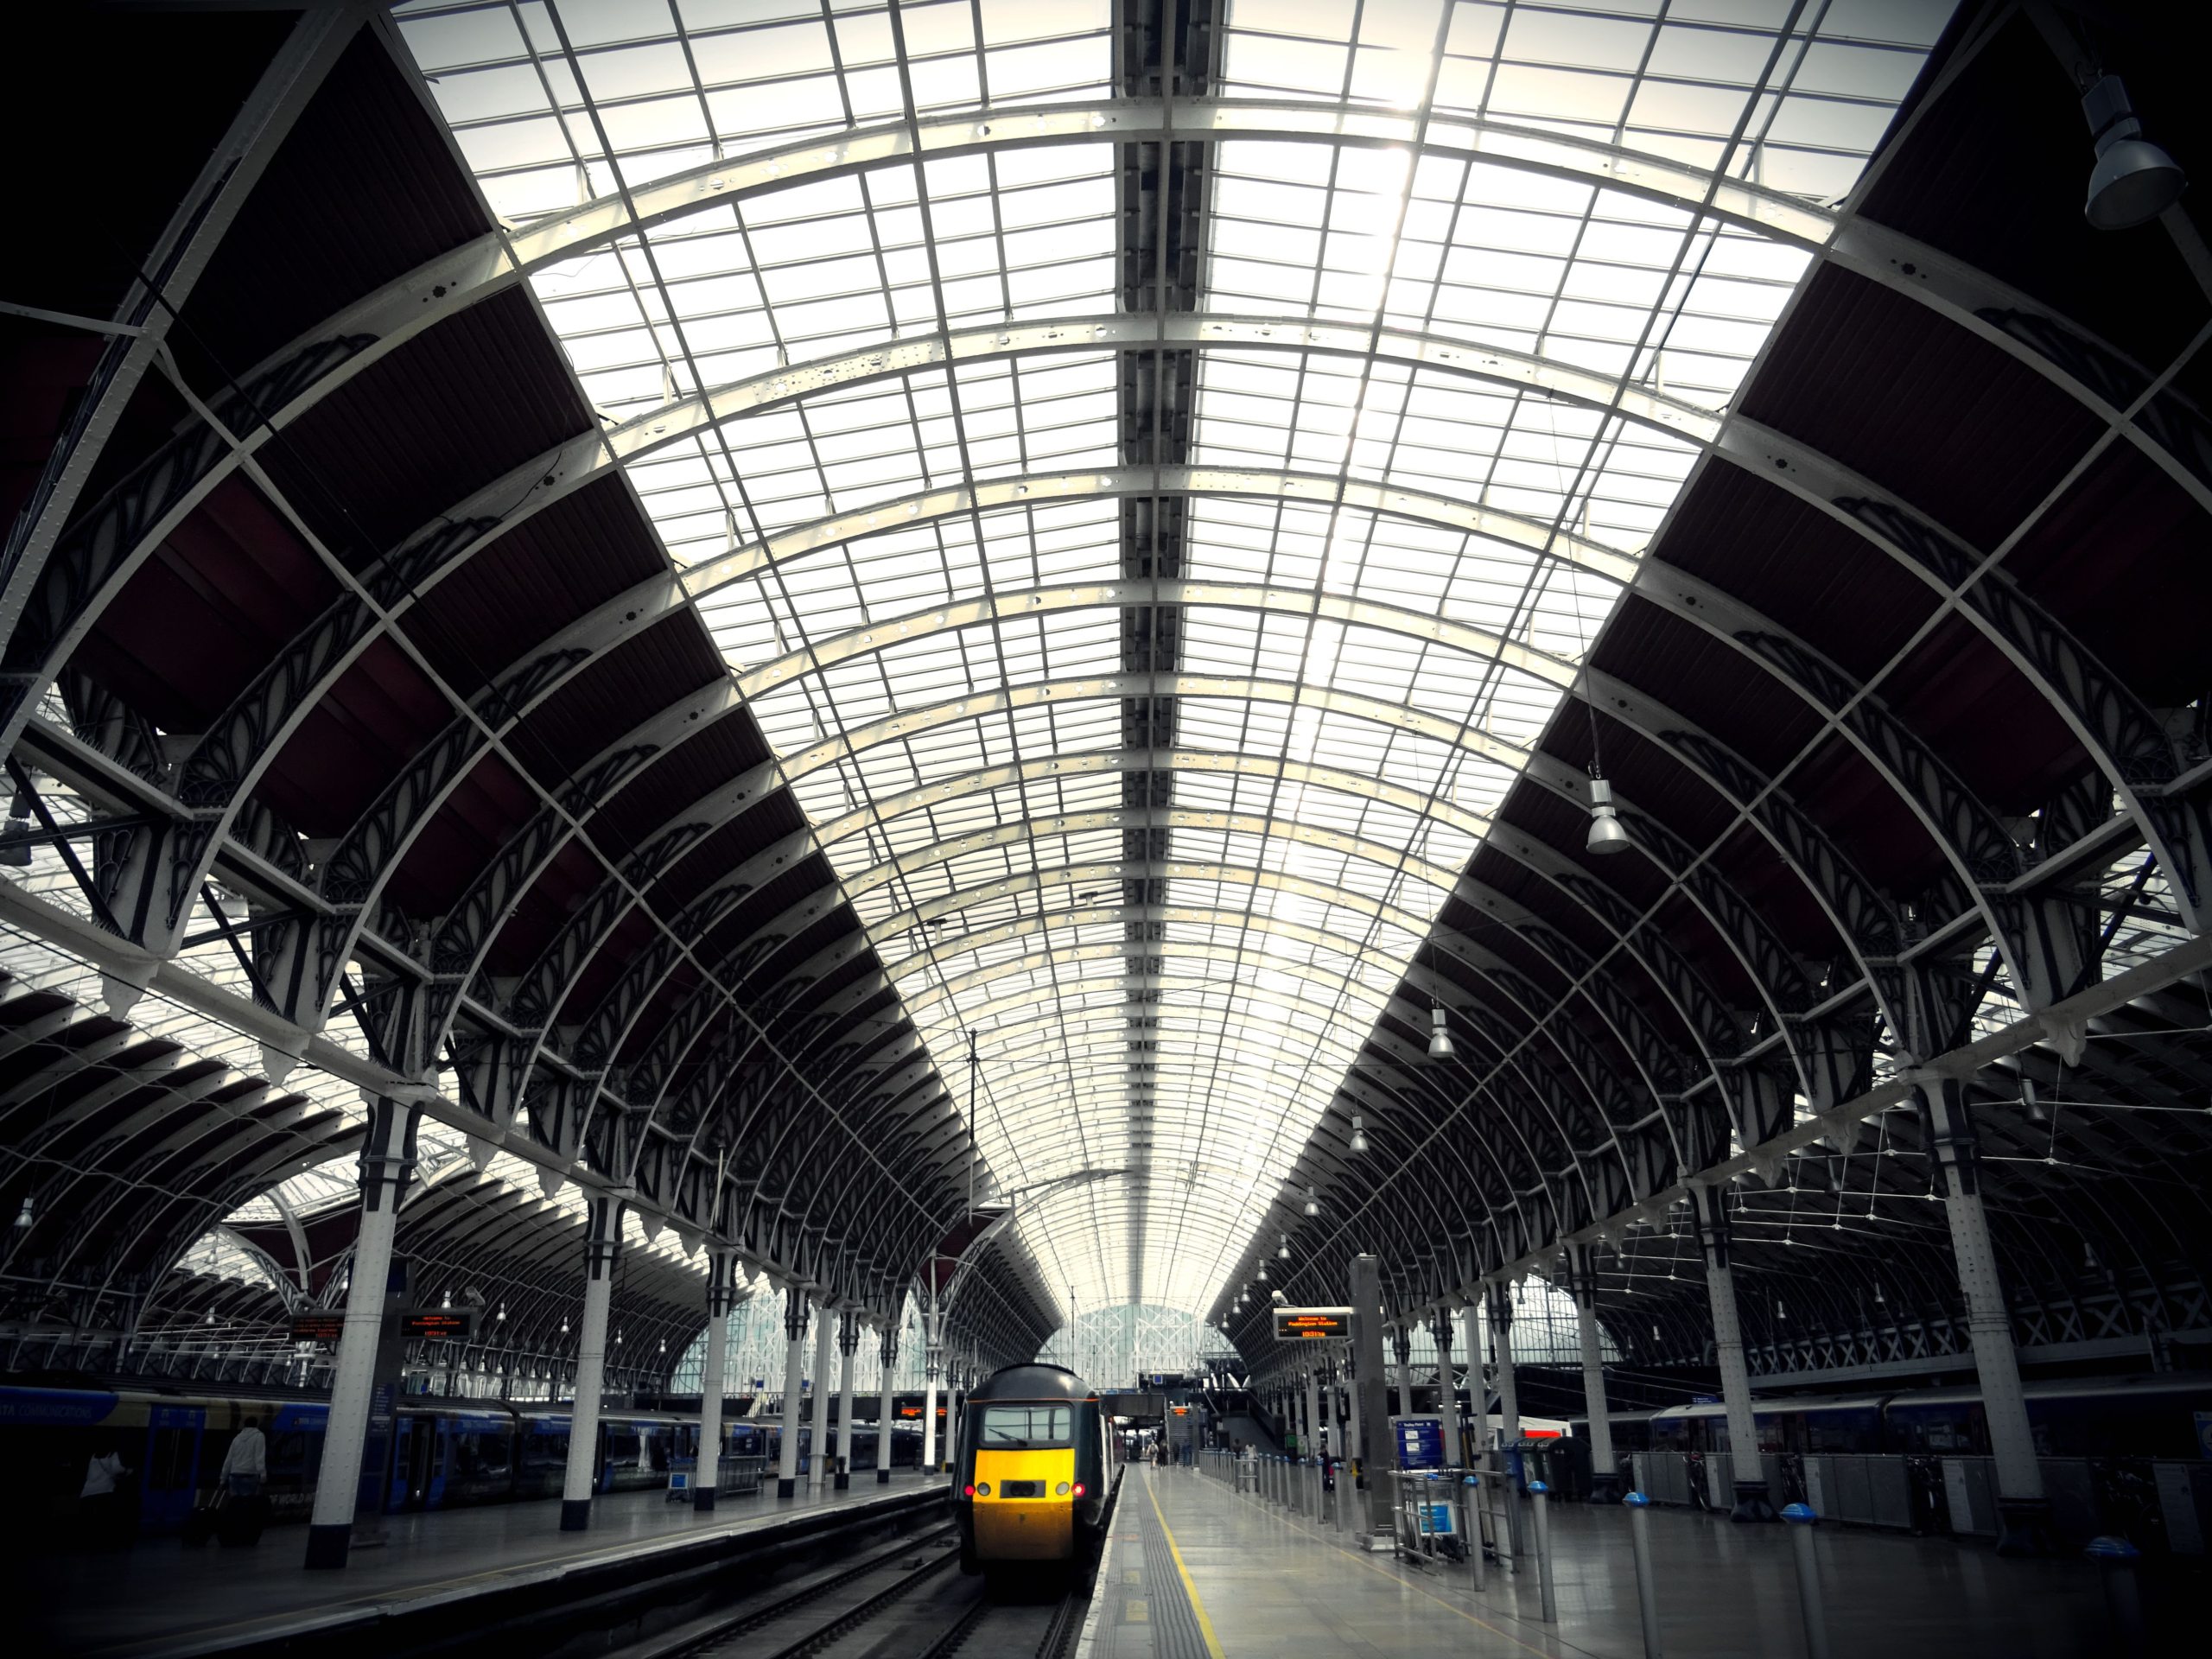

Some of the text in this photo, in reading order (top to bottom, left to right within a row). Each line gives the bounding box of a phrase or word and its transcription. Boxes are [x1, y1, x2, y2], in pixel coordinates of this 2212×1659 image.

[0, 1404, 92, 1419] TA COMMUNICATIONS
[279, 1493, 304, 1505] WORLD
